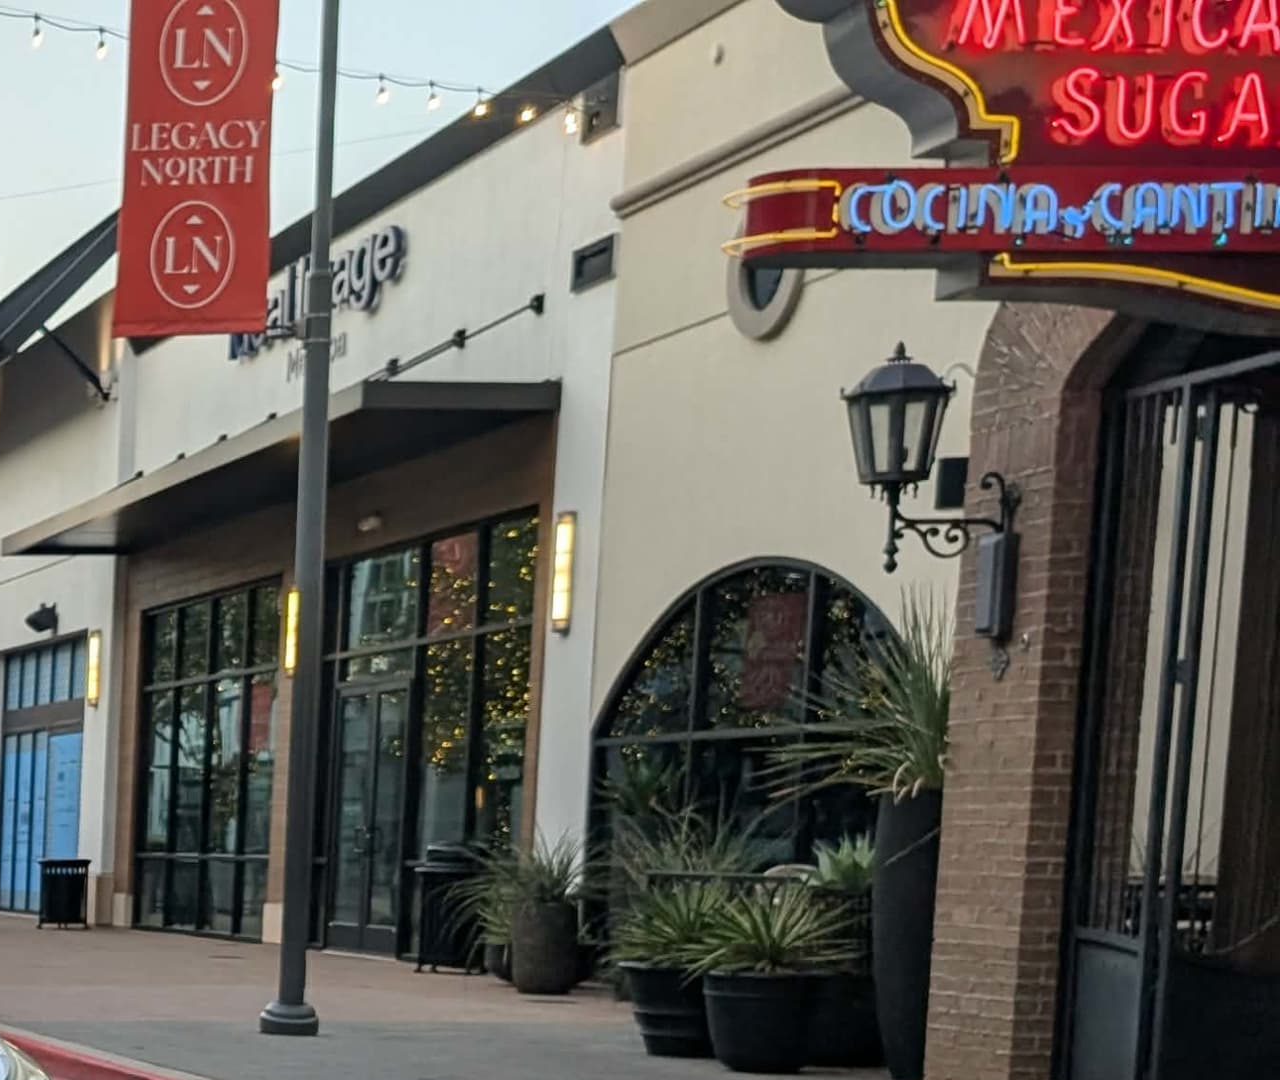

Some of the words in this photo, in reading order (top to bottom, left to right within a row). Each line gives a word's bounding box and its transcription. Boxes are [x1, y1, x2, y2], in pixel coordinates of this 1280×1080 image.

[173, 27, 235, 69] LN
[131, 120, 266, 151] LEGACY
[141, 155, 254, 186] NORTH
[842, 180, 1058, 234] COCINA
[164, 236, 223, 274] LN
[295, 226, 408, 322] Iage
